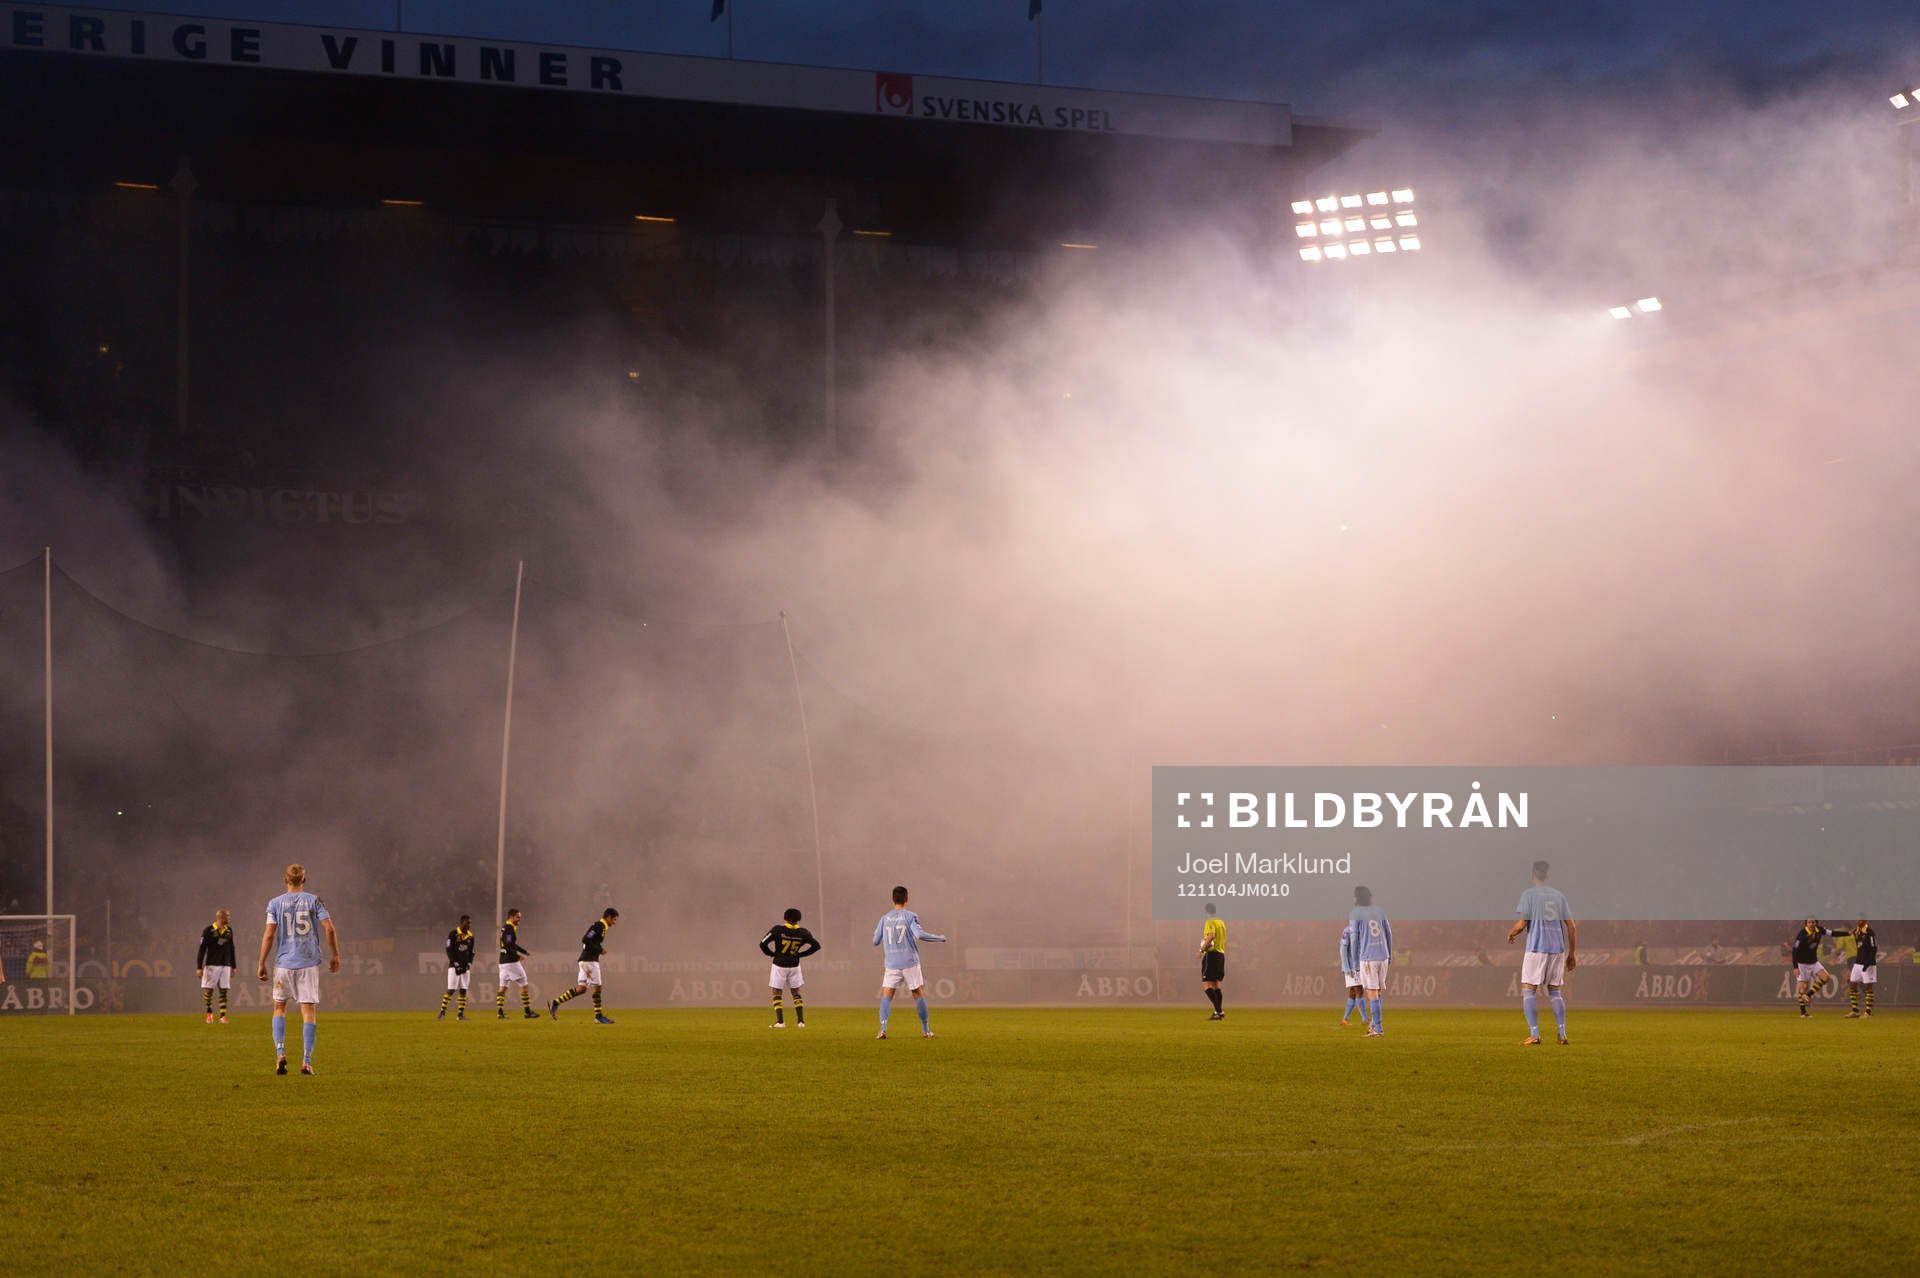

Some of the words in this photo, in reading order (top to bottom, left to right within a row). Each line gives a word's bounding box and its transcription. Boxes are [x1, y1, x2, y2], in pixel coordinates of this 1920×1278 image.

[13, 10, 261, 62] ERIGE
[320, 34, 623, 91] VINNER
[922, 95, 1045, 127] SVENSKA
[1055, 106, 1116, 131] SPEL
[283, 911, 312, 936] 15
[1543, 901, 1557, 922] 5
[885, 924, 907, 945] 17
[1369, 919, 1380, 937] 8
[781, 938, 801, 955] 75
[0, 984, 95, 1010] ÅBRO
[669, 976, 751, 1001] ÅBRO
[1075, 974, 1154, 998] ÅBRO
[1635, 972, 1692, 998] ÅBRO
